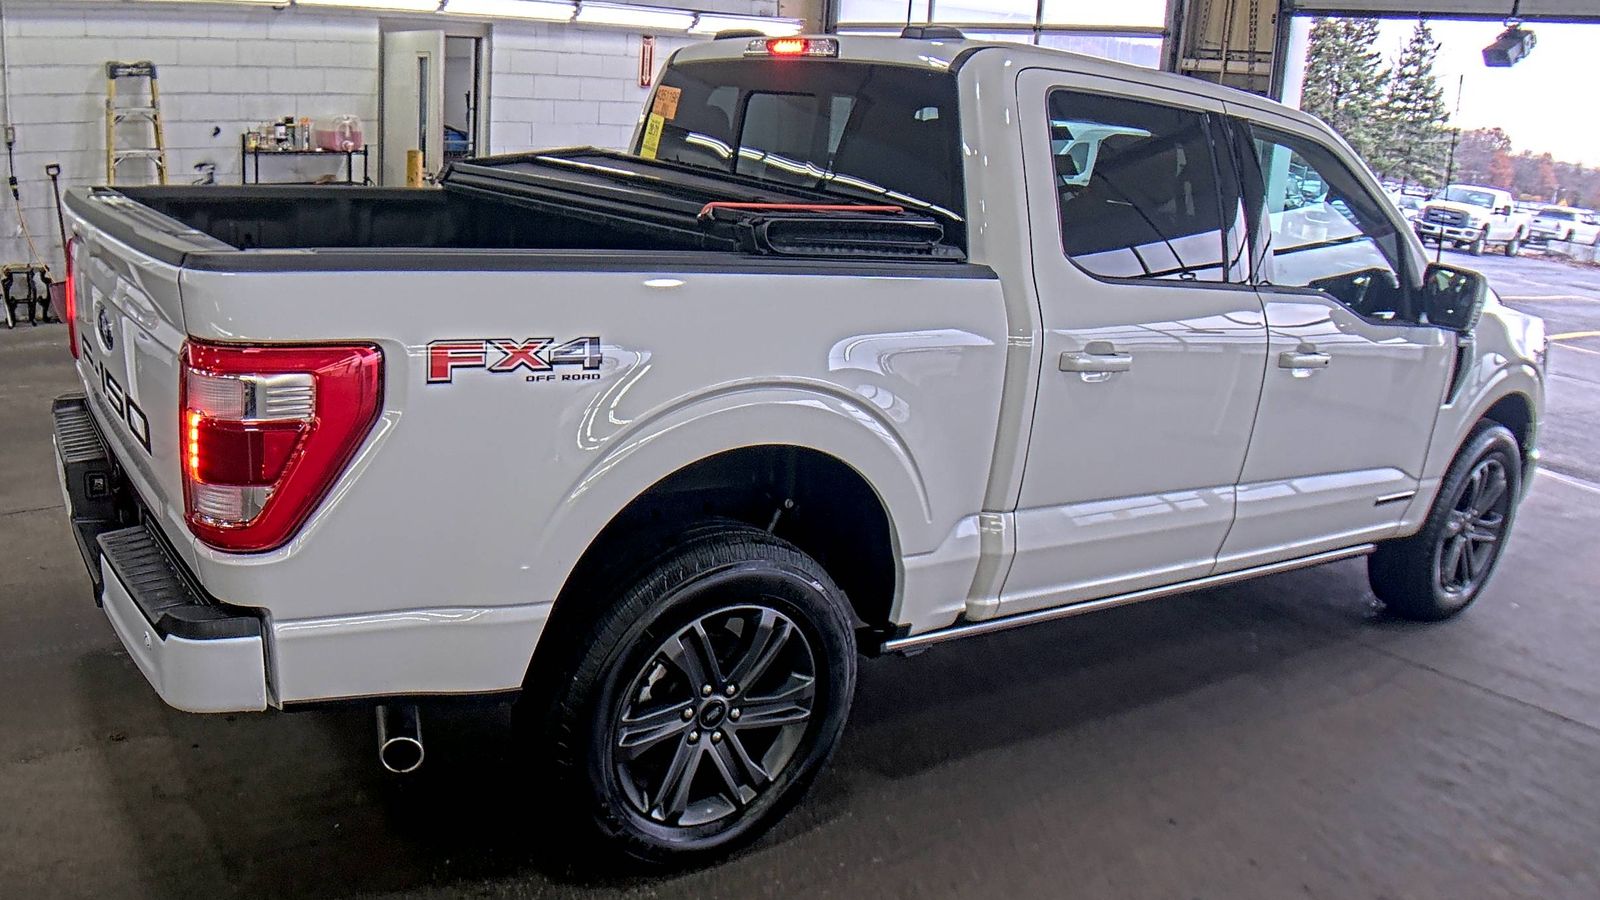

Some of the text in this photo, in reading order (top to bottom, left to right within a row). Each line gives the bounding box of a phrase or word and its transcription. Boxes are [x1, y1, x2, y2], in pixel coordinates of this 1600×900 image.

[426, 337, 602, 384] FX4
[525, 373, 601, 382] OFF ROAD
[82, 333, 152, 457] F-150
